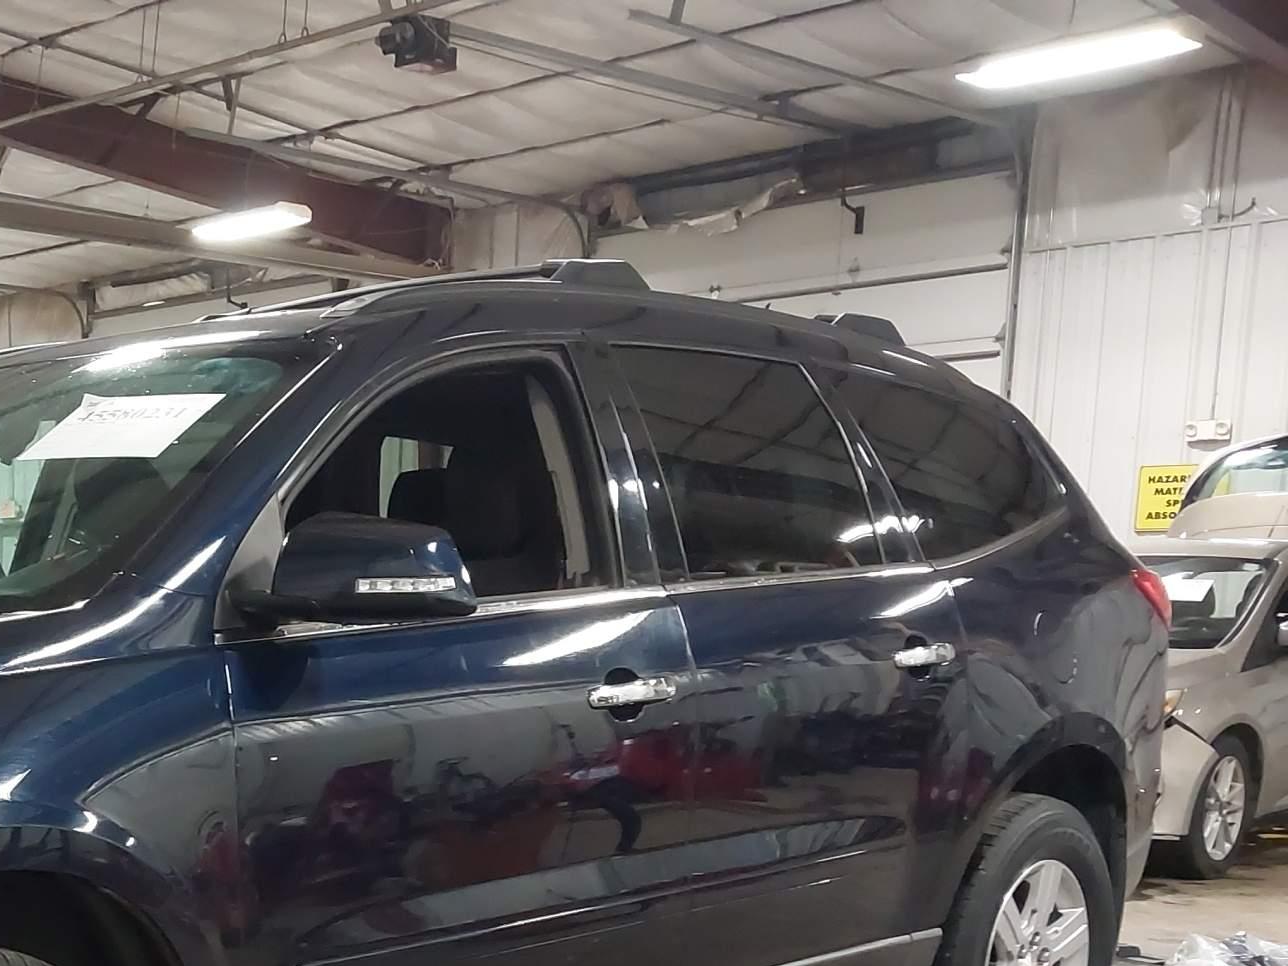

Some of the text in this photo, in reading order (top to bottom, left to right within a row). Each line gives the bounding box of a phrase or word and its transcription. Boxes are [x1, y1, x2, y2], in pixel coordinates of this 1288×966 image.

[1148, 475, 1191, 484] HAZAR
[1165, 499, 1181, 508] SP
[1145, 511, 1178, 520] ABSO
